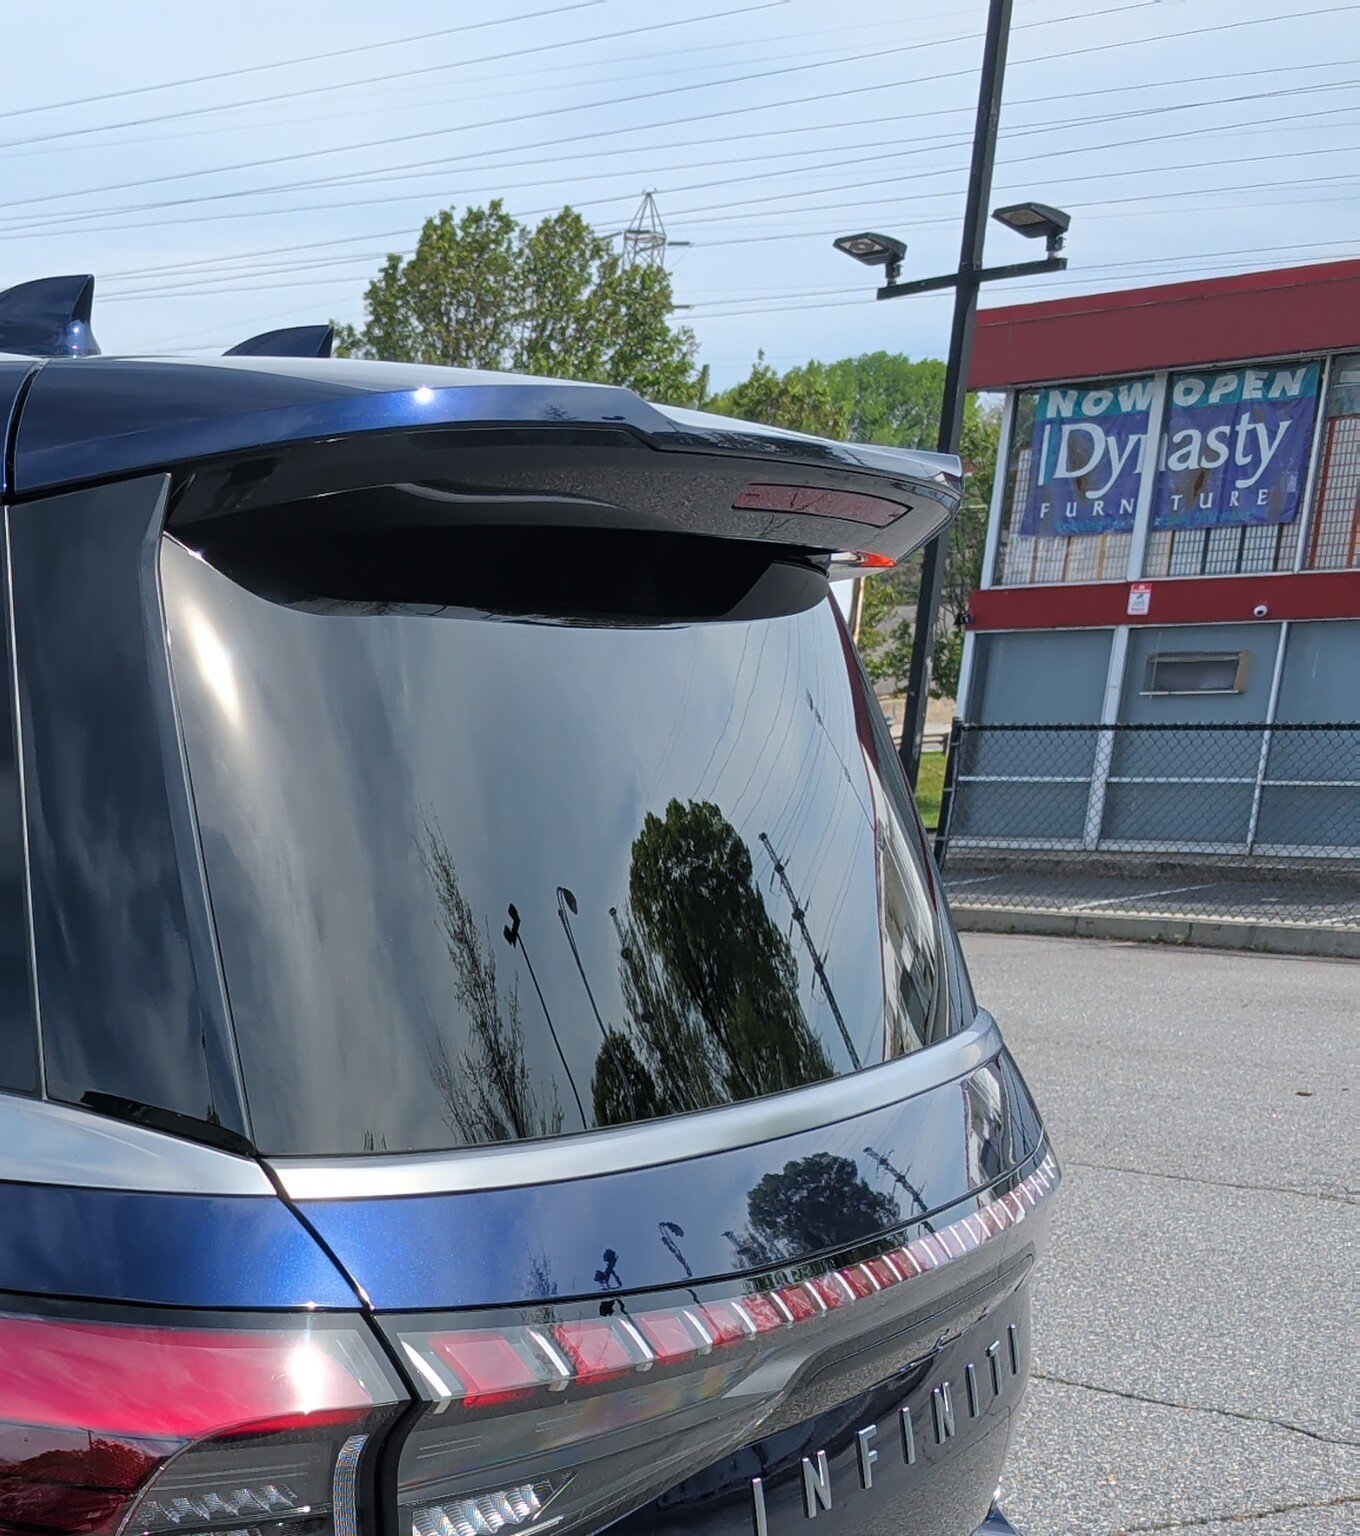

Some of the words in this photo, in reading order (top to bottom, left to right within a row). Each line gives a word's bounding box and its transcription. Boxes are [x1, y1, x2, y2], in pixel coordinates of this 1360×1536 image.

[1045, 381, 1154, 420] NOW
[1171, 367, 1307, 408] OPEN
[1053, 411, 1294, 500] Dynasty
[1038, 488, 1270, 520] FURNTURE
